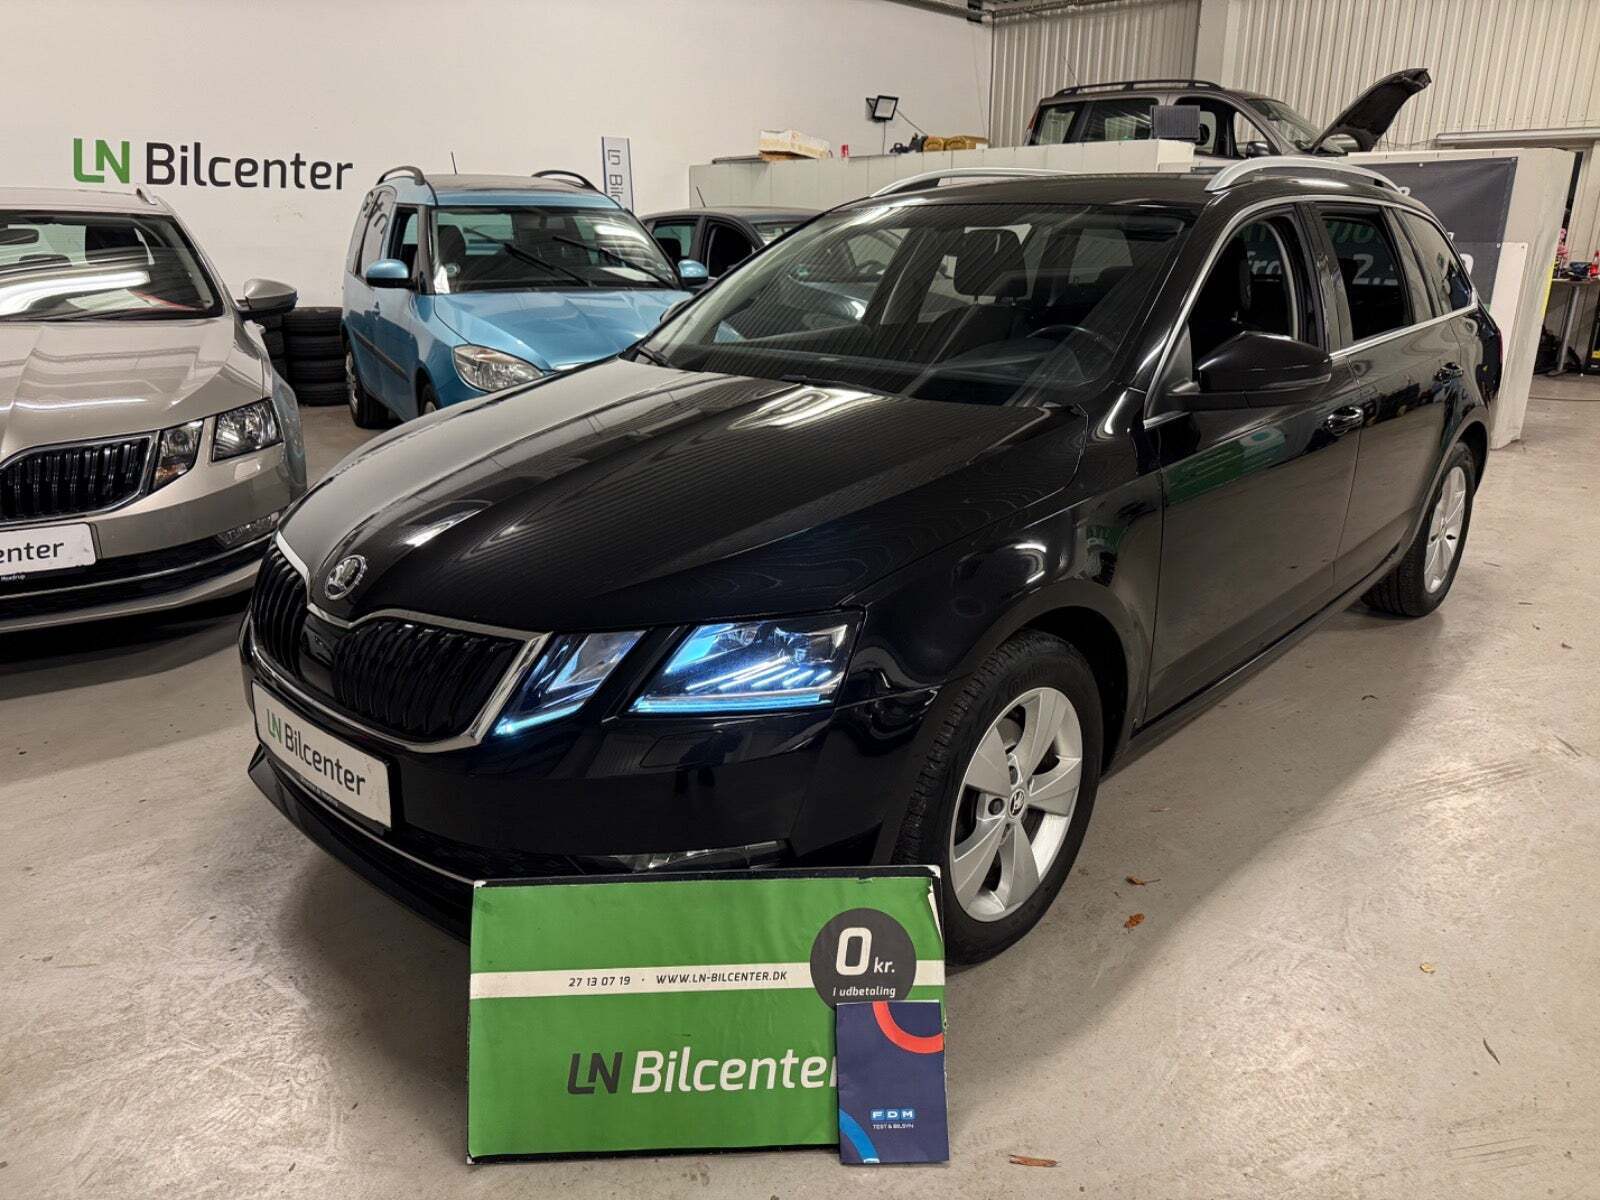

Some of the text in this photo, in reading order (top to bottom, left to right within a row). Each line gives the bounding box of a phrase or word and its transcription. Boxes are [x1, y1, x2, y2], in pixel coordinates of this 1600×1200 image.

[73, 138, 353, 190] LN Bilcenter
[266, 708, 282, 744] LN
[284, 722, 366, 796] Bilcenter
[836, 927, 895, 976] 0 kr.
[568, 971, 788, 987] 27 13 07 19 WWW.LN-BILCENTER.DK
[839, 985, 896, 998] udbetaling
[567, 1051, 623, 1095] LN
[872, 1110, 914, 1119] FDM
